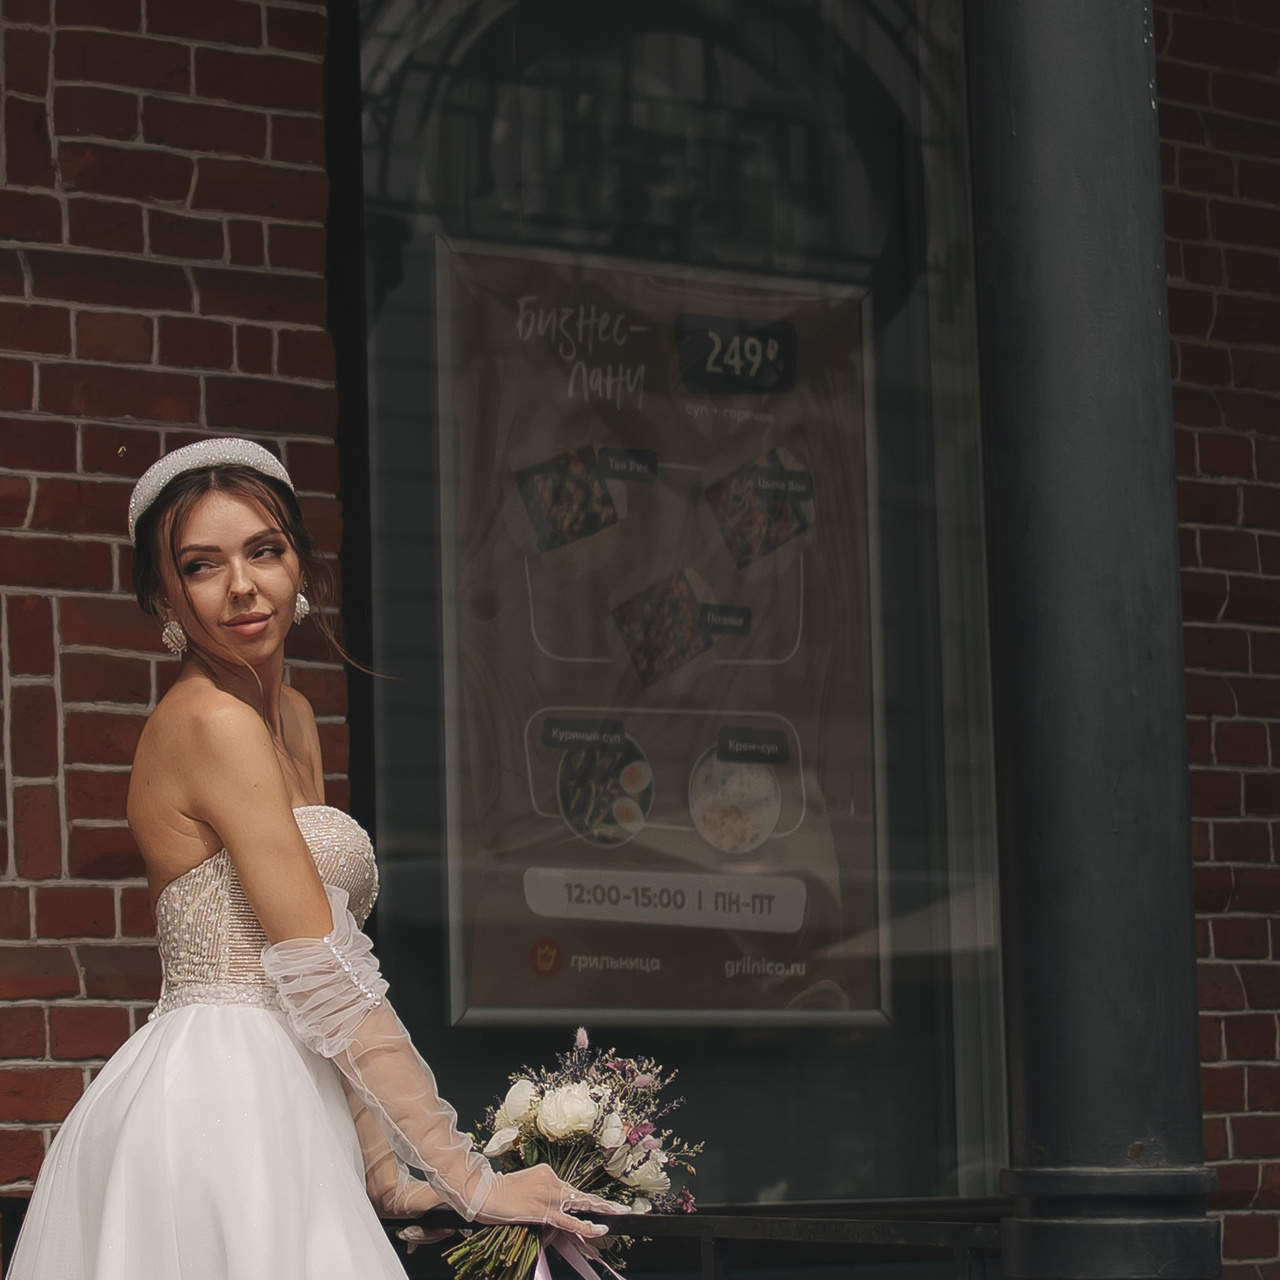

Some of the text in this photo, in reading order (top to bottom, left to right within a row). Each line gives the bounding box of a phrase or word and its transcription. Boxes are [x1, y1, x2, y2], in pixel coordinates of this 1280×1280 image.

[516, 295, 649, 362] Бизнес-
[567, 361, 646, 411] Ланч
[684, 403, 708, 418] суп
[551, 727, 621, 745] Куриный суп
[564, 882, 686, 910] 12:00-15:00
[713, 892, 776, 915] ПН-ПТ
[571, 953, 660, 972] грильница
[725, 956, 806, 978] grilnica.ru
